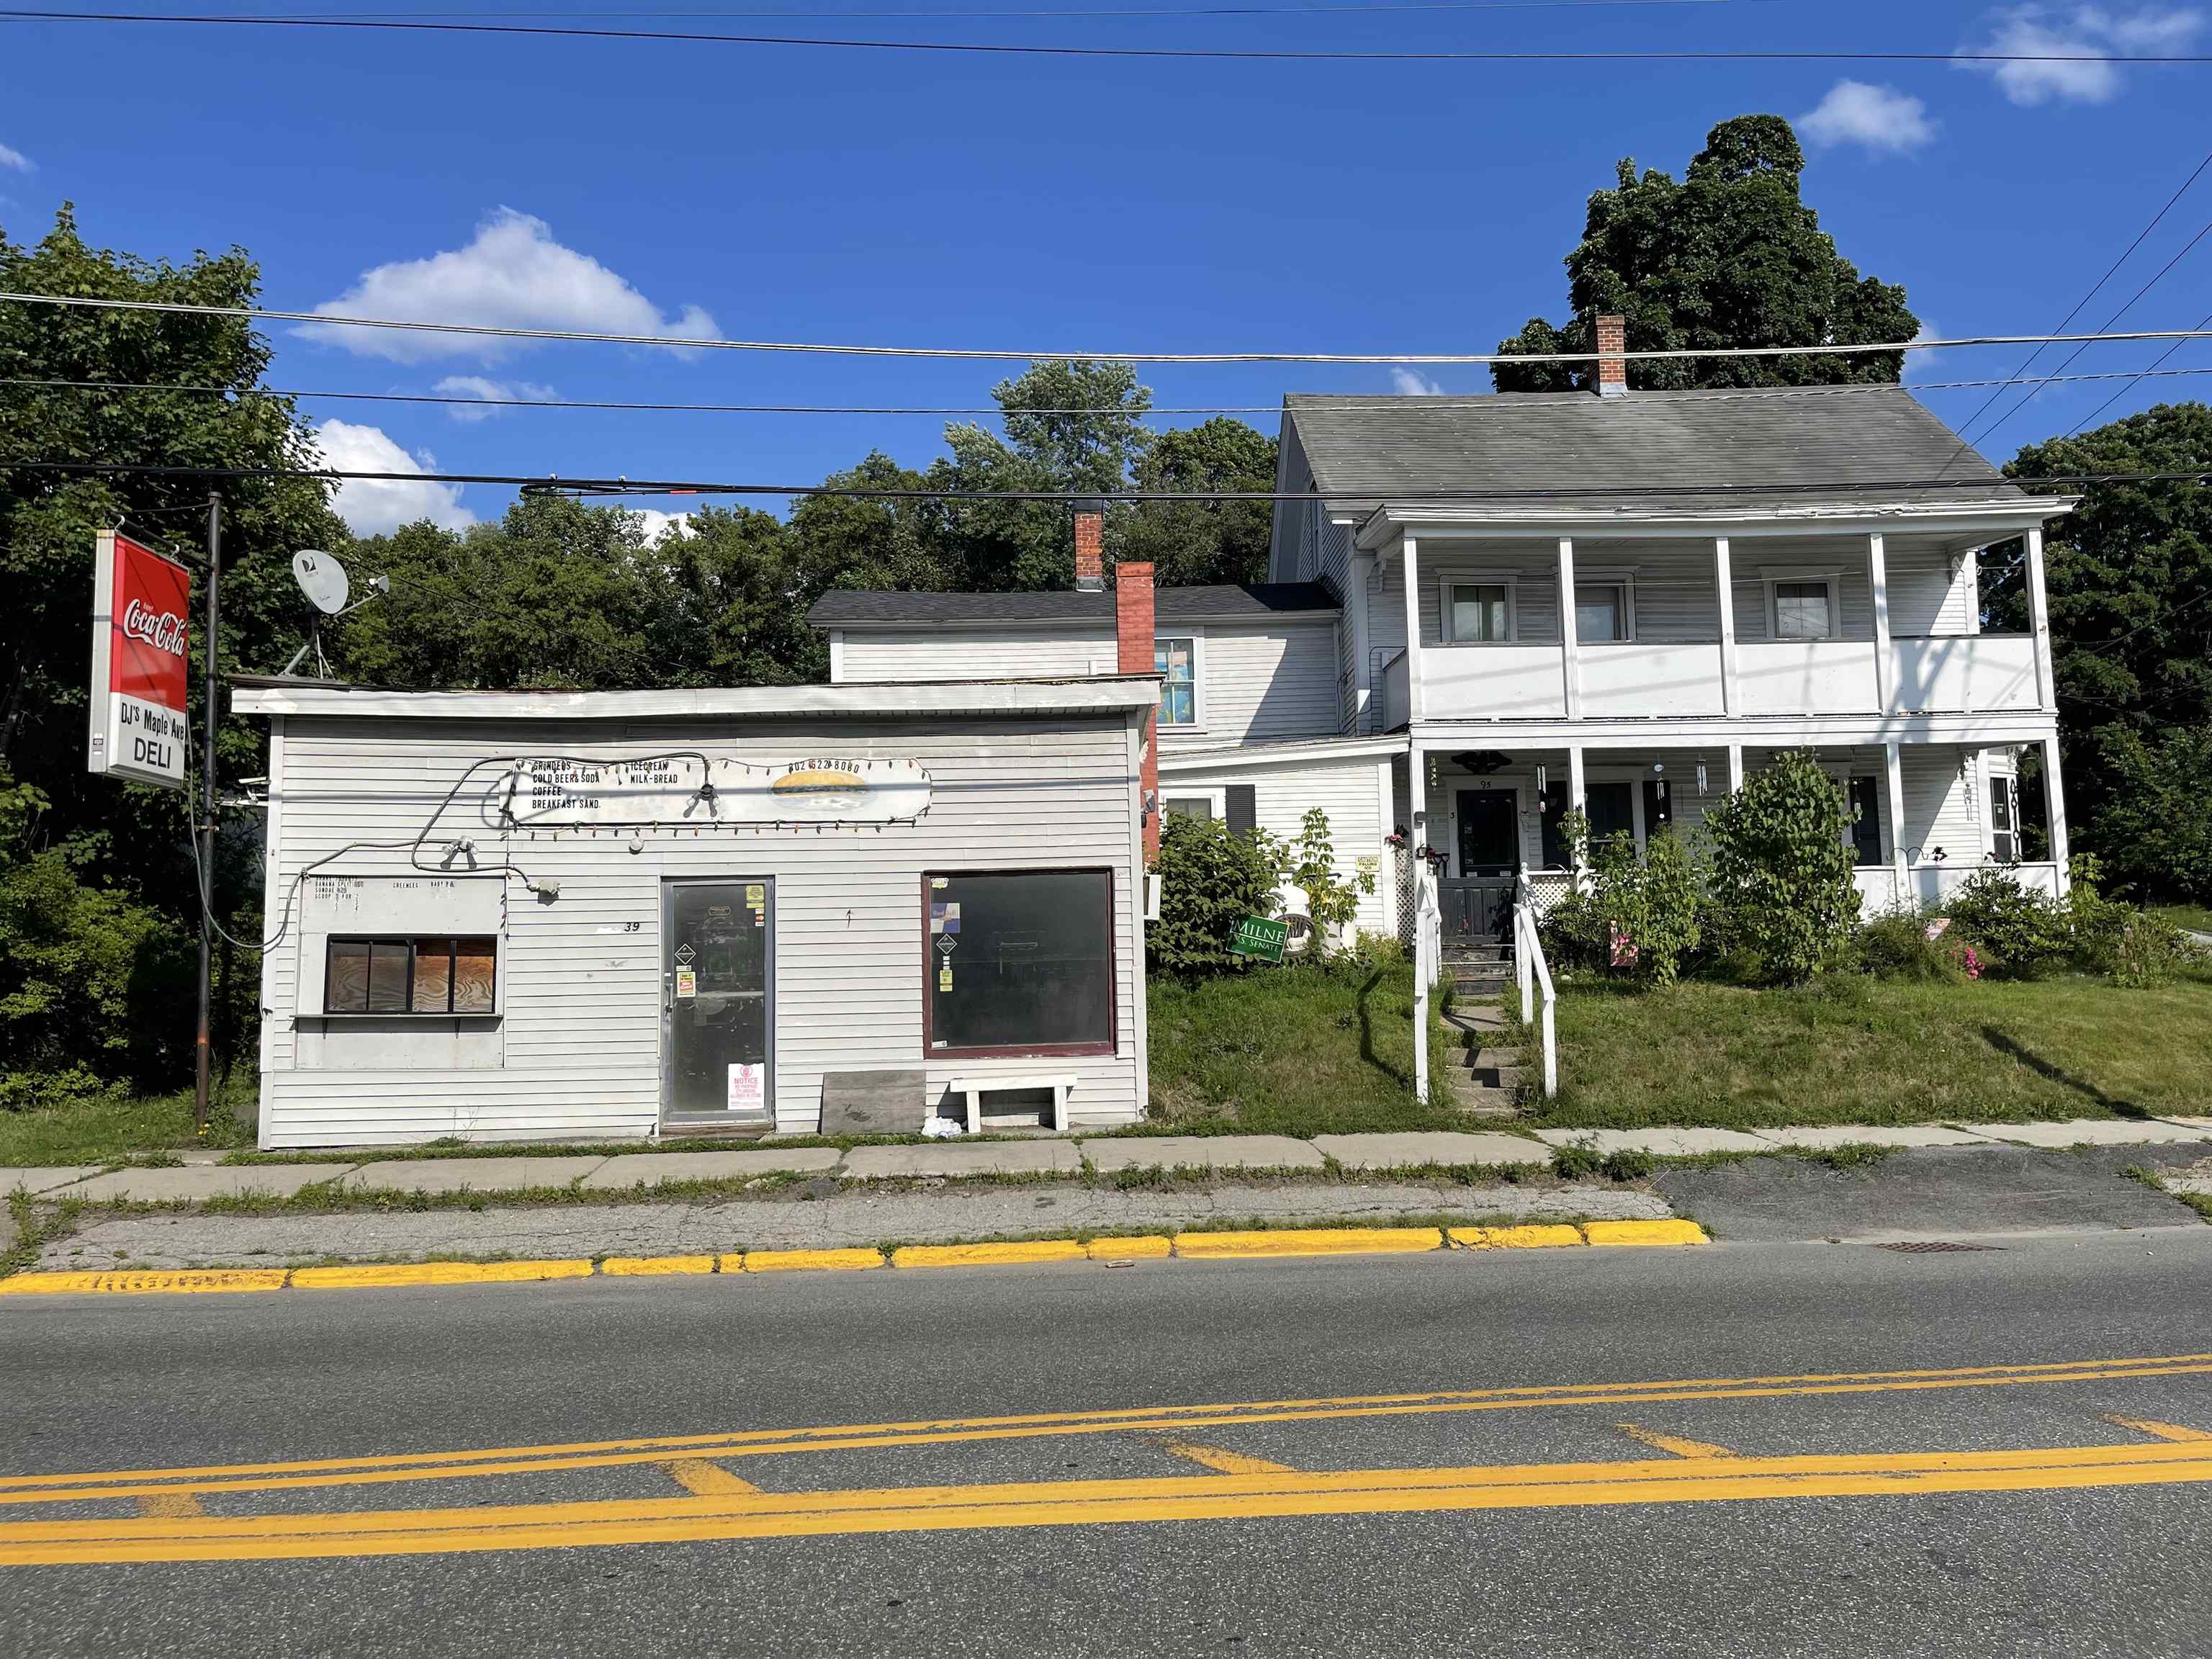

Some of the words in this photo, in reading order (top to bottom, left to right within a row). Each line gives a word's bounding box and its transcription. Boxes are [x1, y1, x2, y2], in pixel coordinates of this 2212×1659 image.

[124, 598, 187, 657] Coca-Cola
[144, 709, 168, 737] Maple
[171, 718, 184, 740] Ave
[134, 737, 171, 769] DELI
[533, 773, 552, 783] COLD
[581, 773, 600, 783] SODA
[533, 787, 562, 796] COFFEE
[532, 799, 577, 809] BREAKFAST
[624, 922, 639, 932] 39
[1230, 920, 1285, 943] MILNE
[1249, 939, 1279, 952] SENATE
